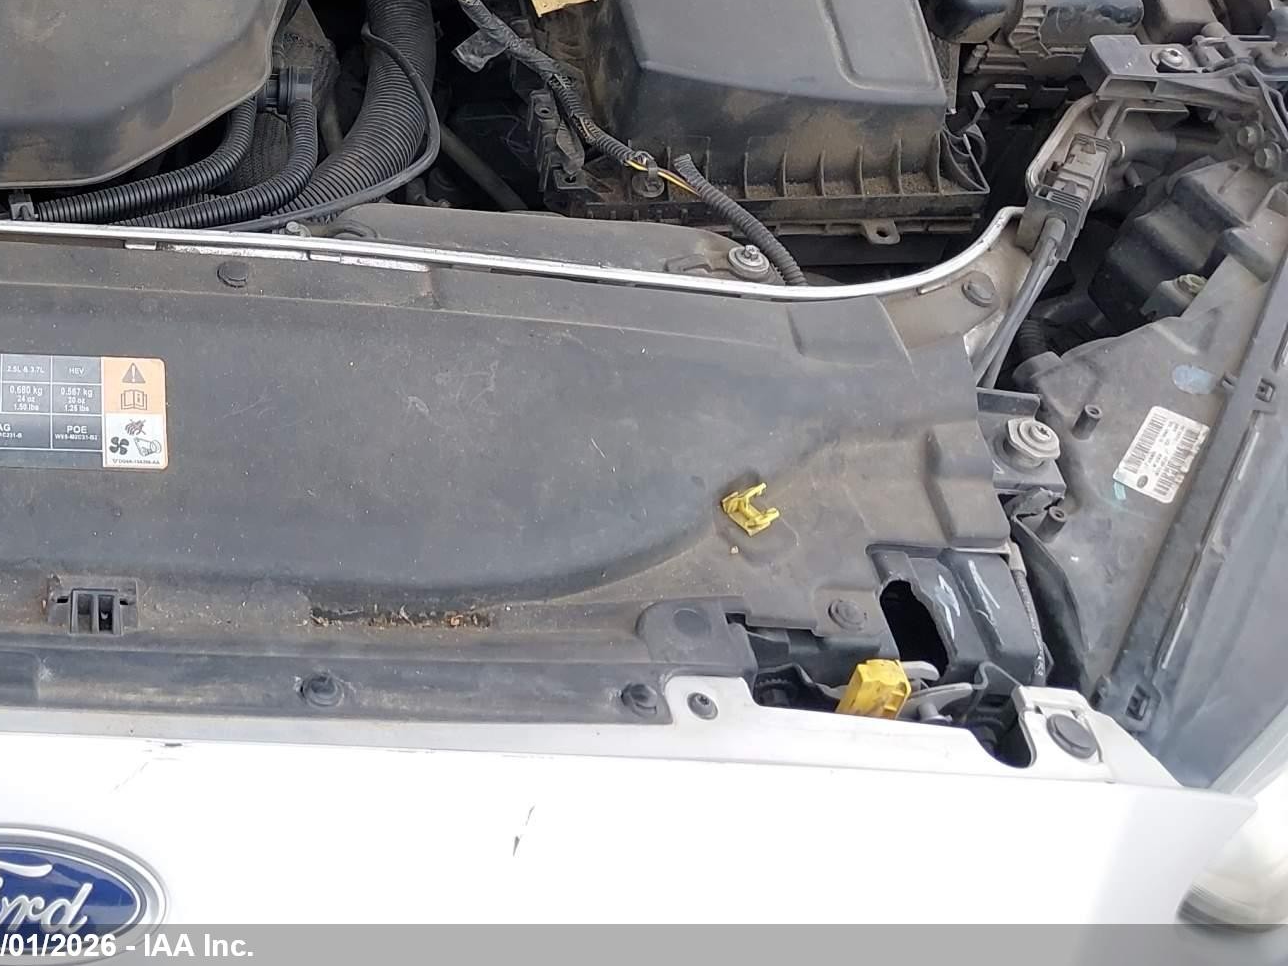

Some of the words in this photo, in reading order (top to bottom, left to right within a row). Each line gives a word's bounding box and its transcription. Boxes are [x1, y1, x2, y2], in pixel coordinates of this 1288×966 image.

[68, 367, 85, 375] HEV
[9, 385, 31, 395] 0.680
[32, 386, 43, 396] kg
[60, 387, 81, 396] 0.567
[83, 387, 93, 398] kg
[65, 404, 78, 412] 1.25
[66, 425, 88, 434] POE
